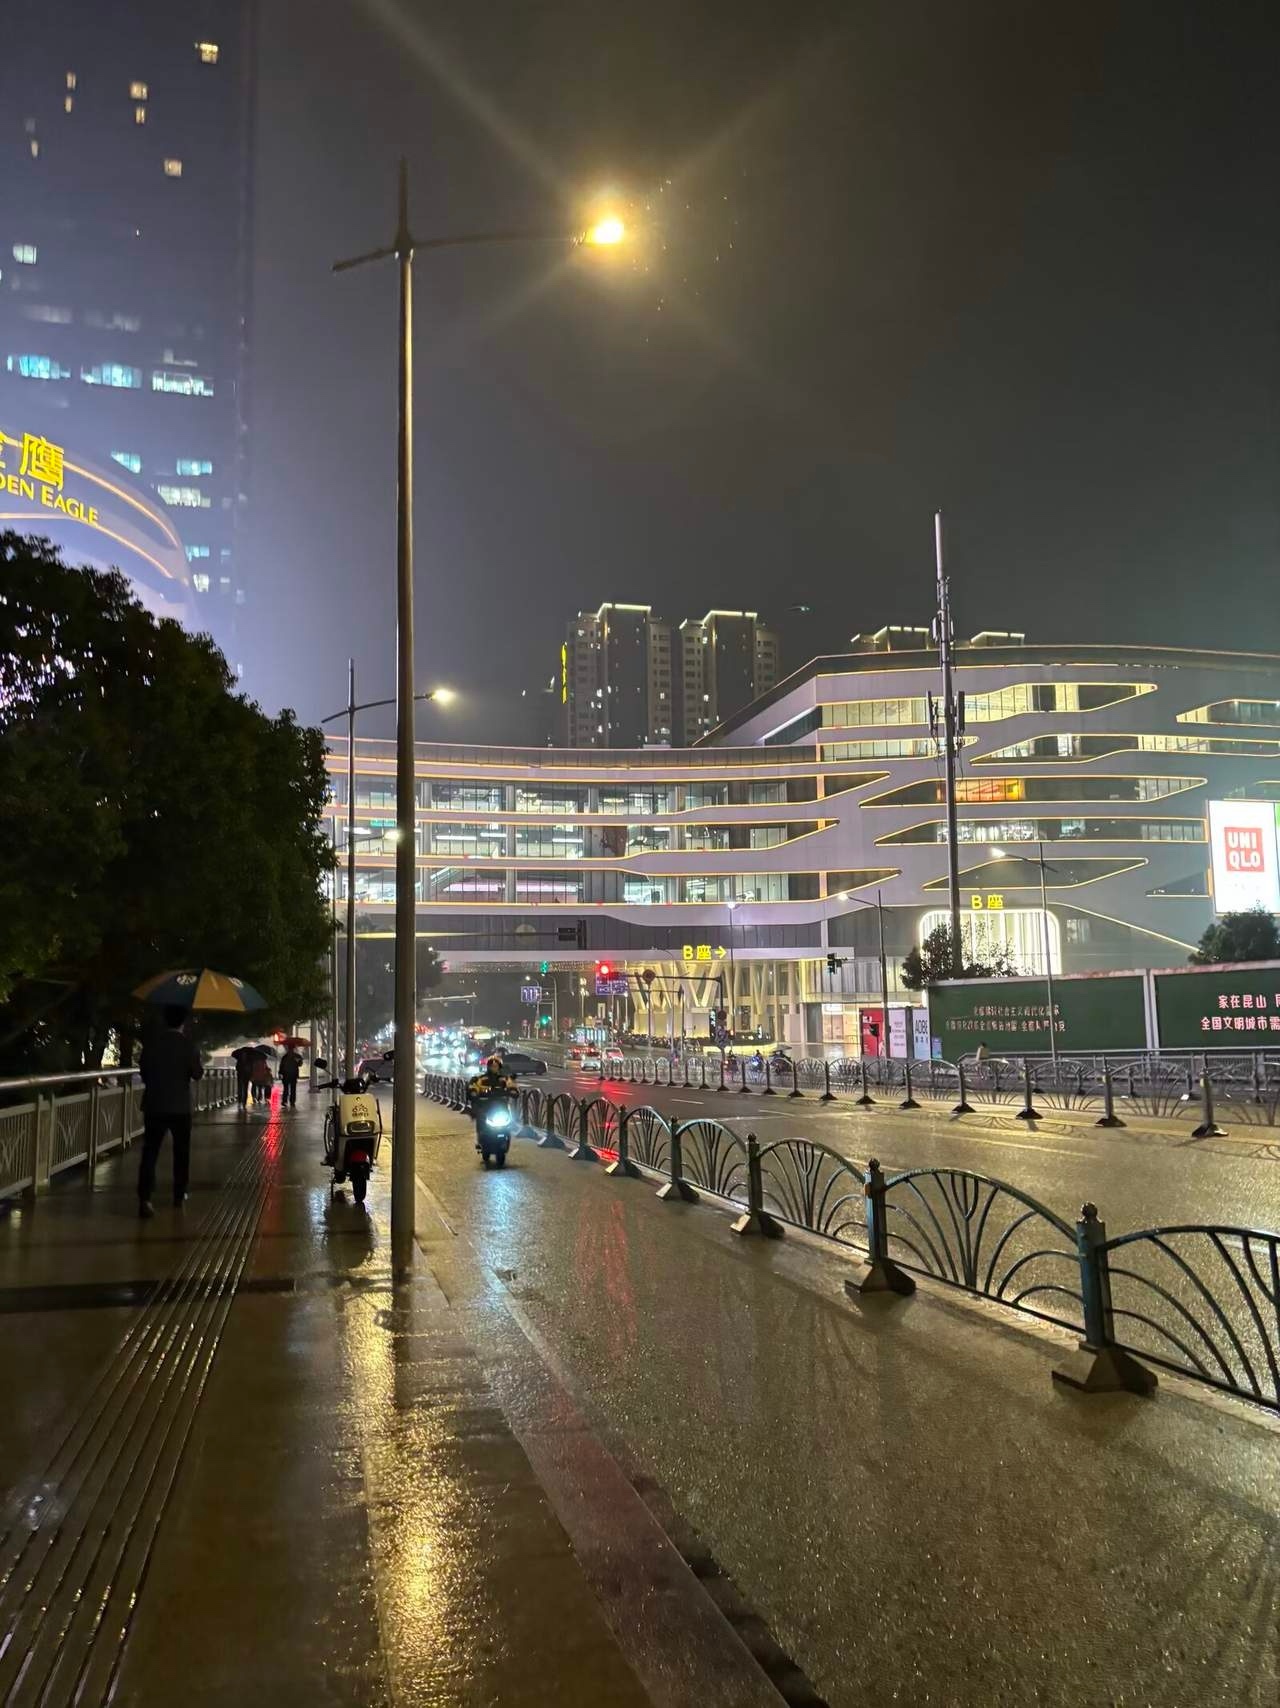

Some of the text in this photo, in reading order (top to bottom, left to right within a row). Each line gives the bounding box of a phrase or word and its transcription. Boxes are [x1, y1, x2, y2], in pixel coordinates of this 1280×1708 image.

[0, 431, 64, 491] 鹰
[41, 485, 98, 528] EAGLE
[1228, 831, 1258, 849] UNI
[1229, 850, 1261, 870] QLO
[1218, 994, 1267, 1009] 家在昆山
[1201, 1016, 1280, 1031] 全国文明城市需
